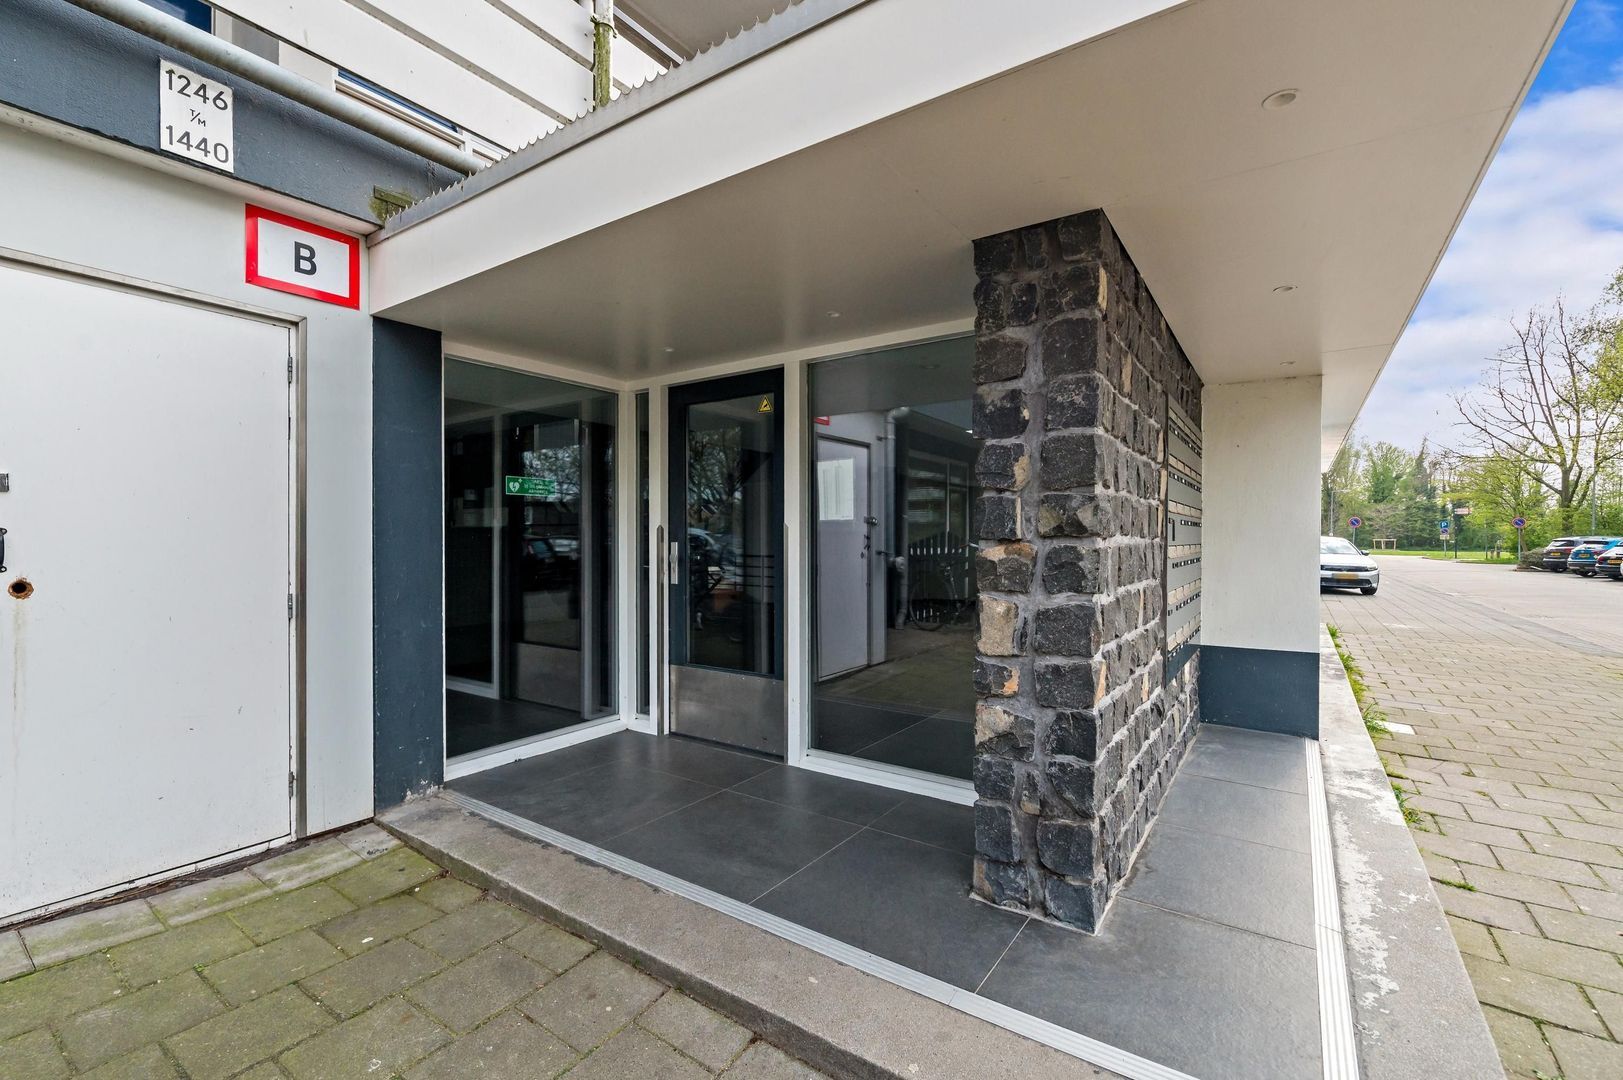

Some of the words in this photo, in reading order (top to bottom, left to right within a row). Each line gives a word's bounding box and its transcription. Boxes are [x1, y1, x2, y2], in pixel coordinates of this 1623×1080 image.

[165, 68, 228, 111] 1246
[189, 108, 206, 127] T/M
[165, 125, 229, 163] 1440
[294, 241, 317, 275] B
